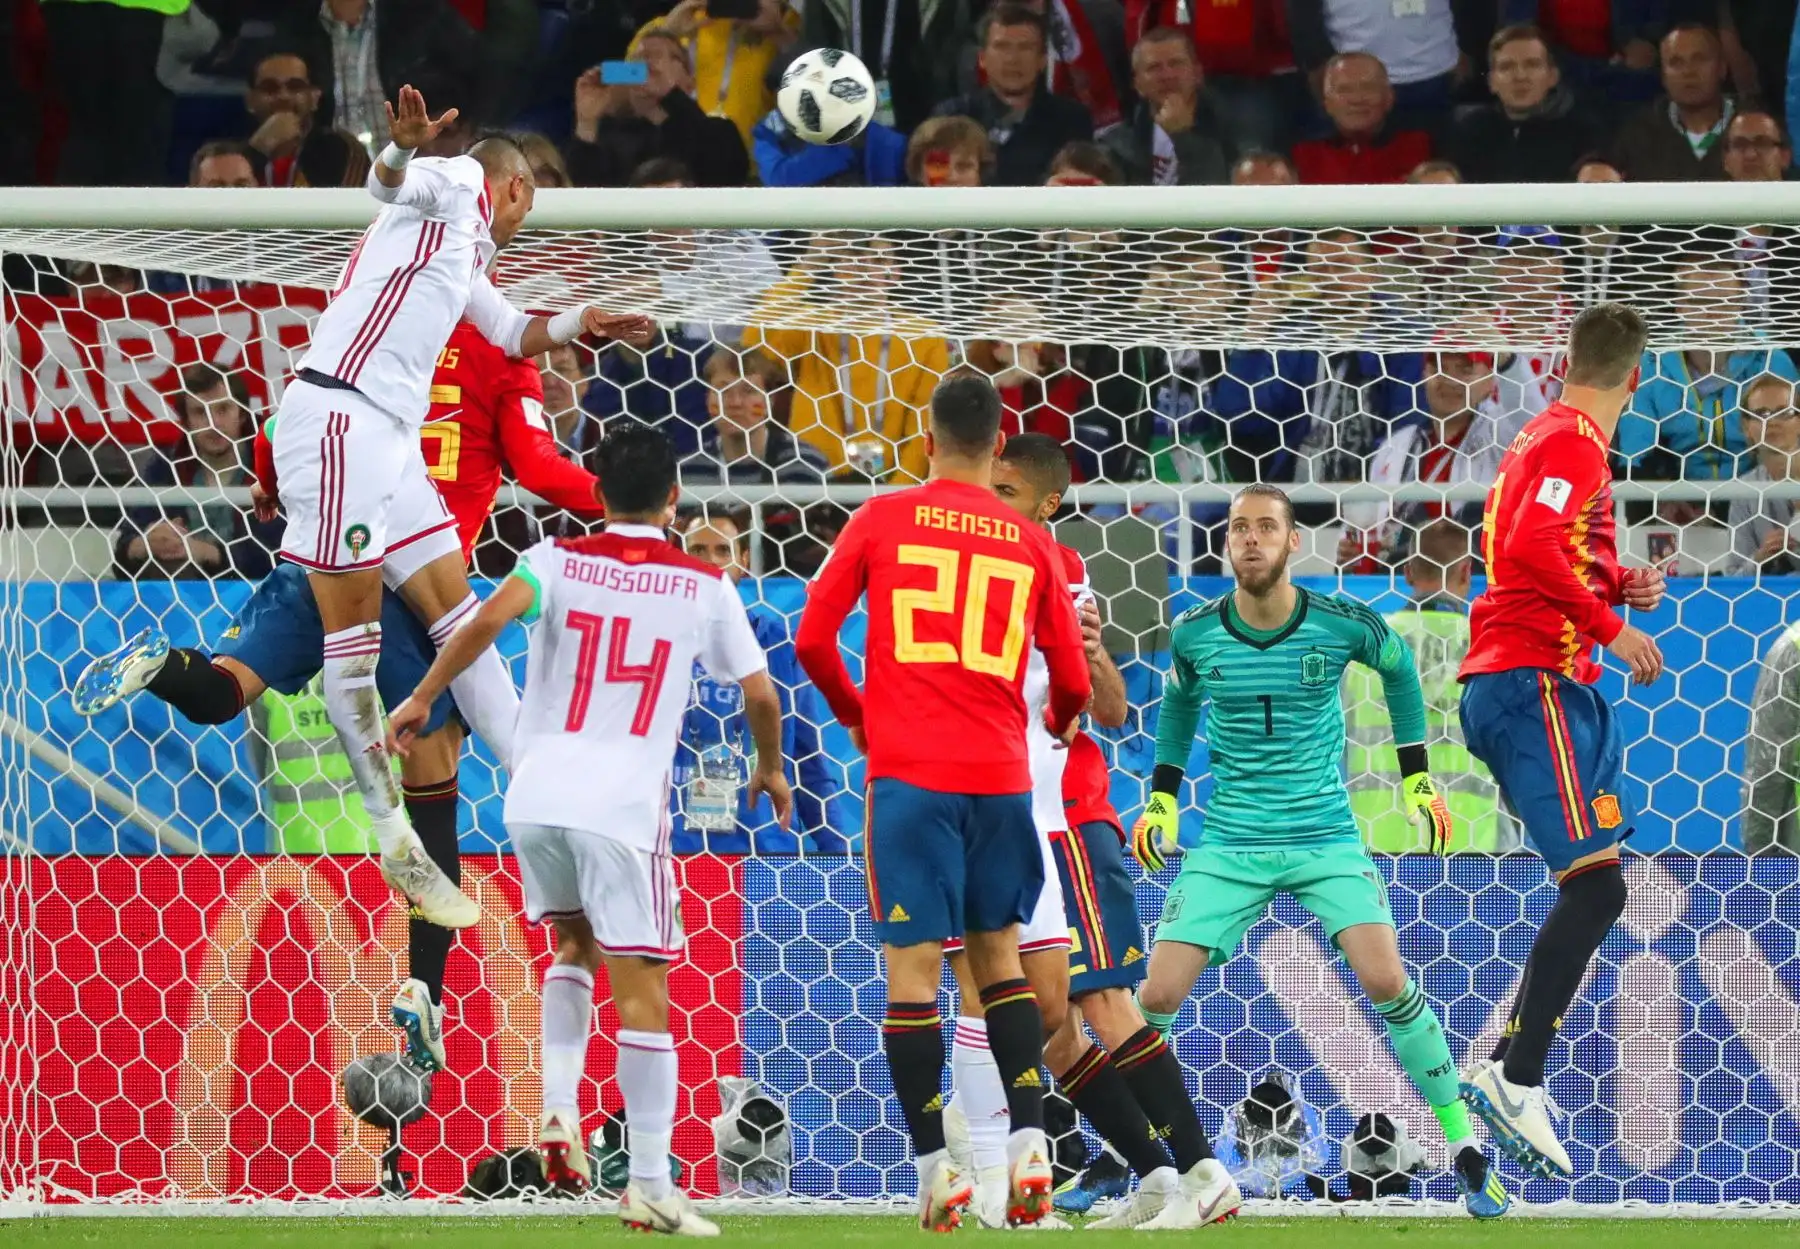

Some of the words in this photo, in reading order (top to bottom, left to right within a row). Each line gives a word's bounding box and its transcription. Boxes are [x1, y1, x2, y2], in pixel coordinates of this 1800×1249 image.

[914, 505, 1020, 543] ASENSIO
[564, 558, 698, 601] BOUSSOUFA
[892, 544, 1035, 682] 20
[564, 609, 672, 737] 14
[1256, 694, 1274, 736] 1
